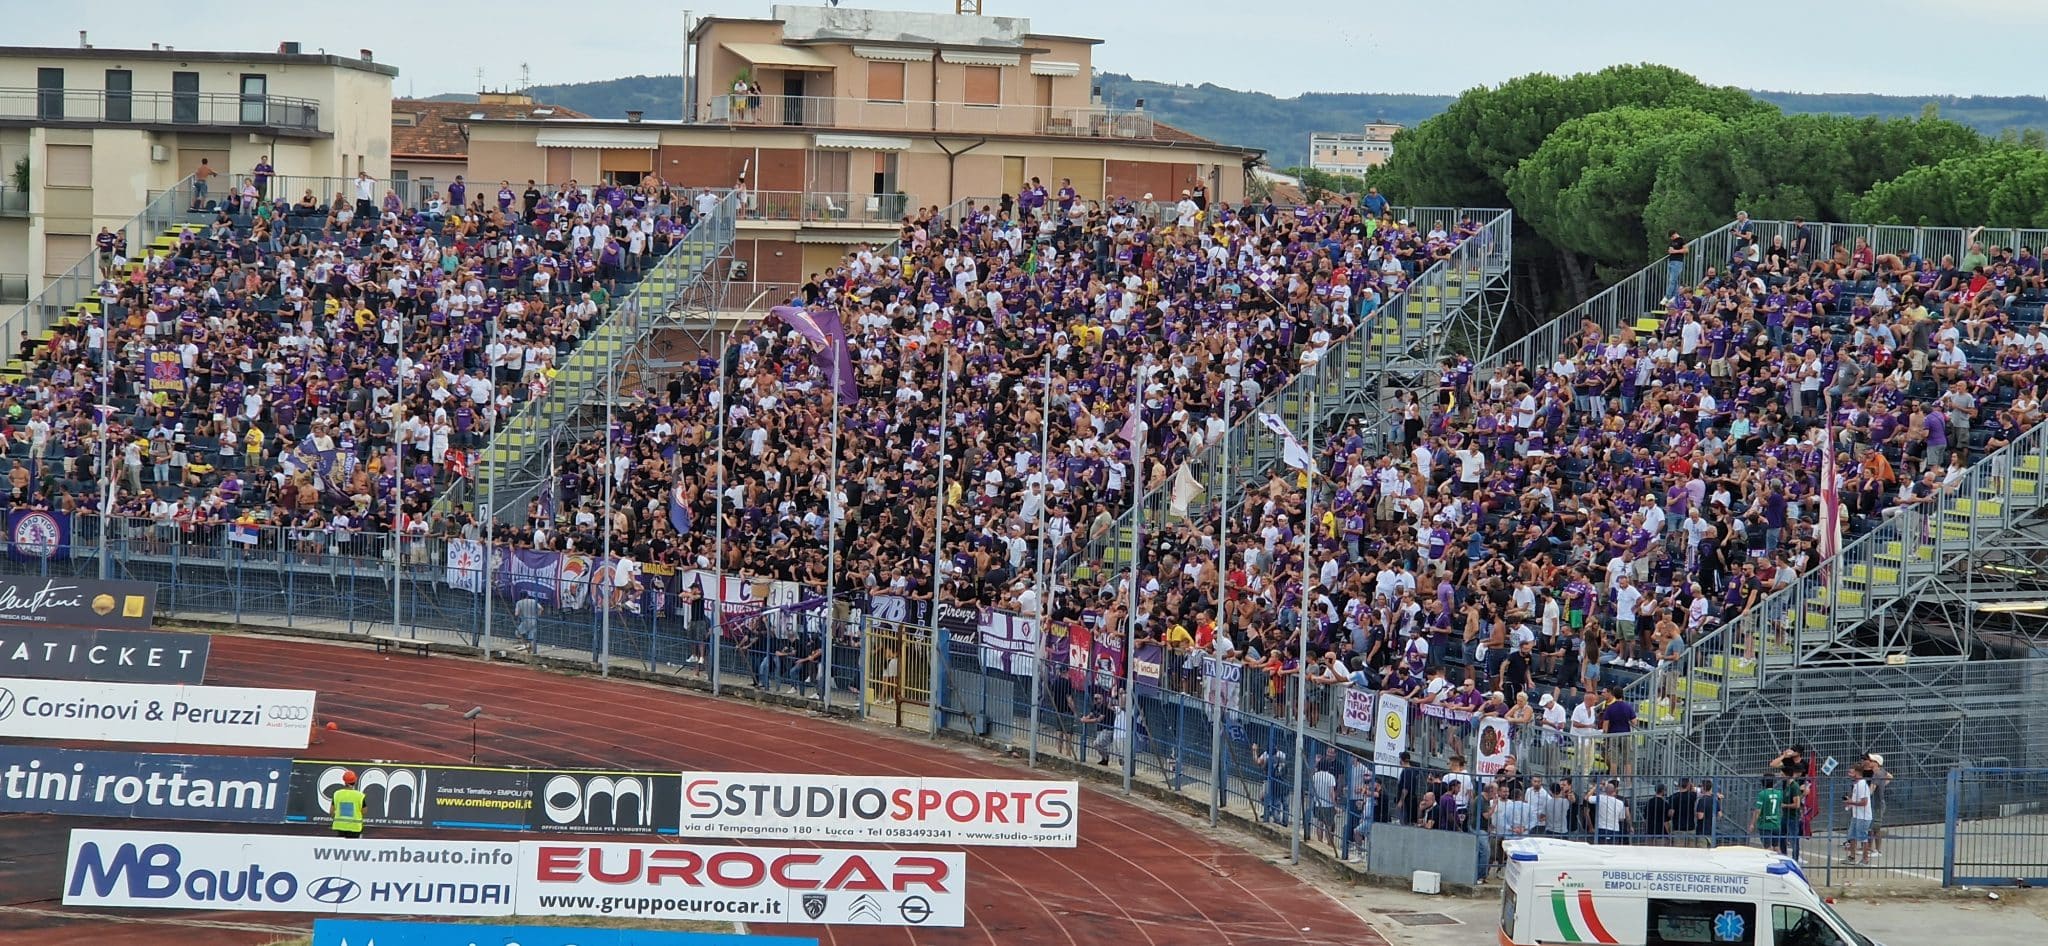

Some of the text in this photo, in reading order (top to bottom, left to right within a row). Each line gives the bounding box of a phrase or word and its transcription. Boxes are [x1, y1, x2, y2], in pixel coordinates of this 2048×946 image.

[938, 603, 976, 624] Firenze
[948, 631, 976, 645] sual
[0, 640, 193, 669] ATICKET
[22, 695, 261, 725] Corsinovi & Peruzzi
[94, 770, 279, 810] rottami
[497, 789, 522, 797] EMPOLI
[436, 797, 532, 810] www.omiempoli.it
[685, 823, 1072, 843] via di Tempagnano 180 Lucca Tel 0583493341 www.studio-sport.it
[313, 846, 513, 865] www.mbauto.info
[537, 846, 951, 893] EUROCAR
[1602, 870, 1749, 885] PUBBLICHE ASSISTENZE RIUNITE
[370, 882, 510, 905] HYUNDAI
[1604, 881, 1642, 891] EMPOLI
[1649, 883, 1747, 895] CASTELFIORENTINO
[539, 895, 782, 915] www.gruppoeurocar.it
